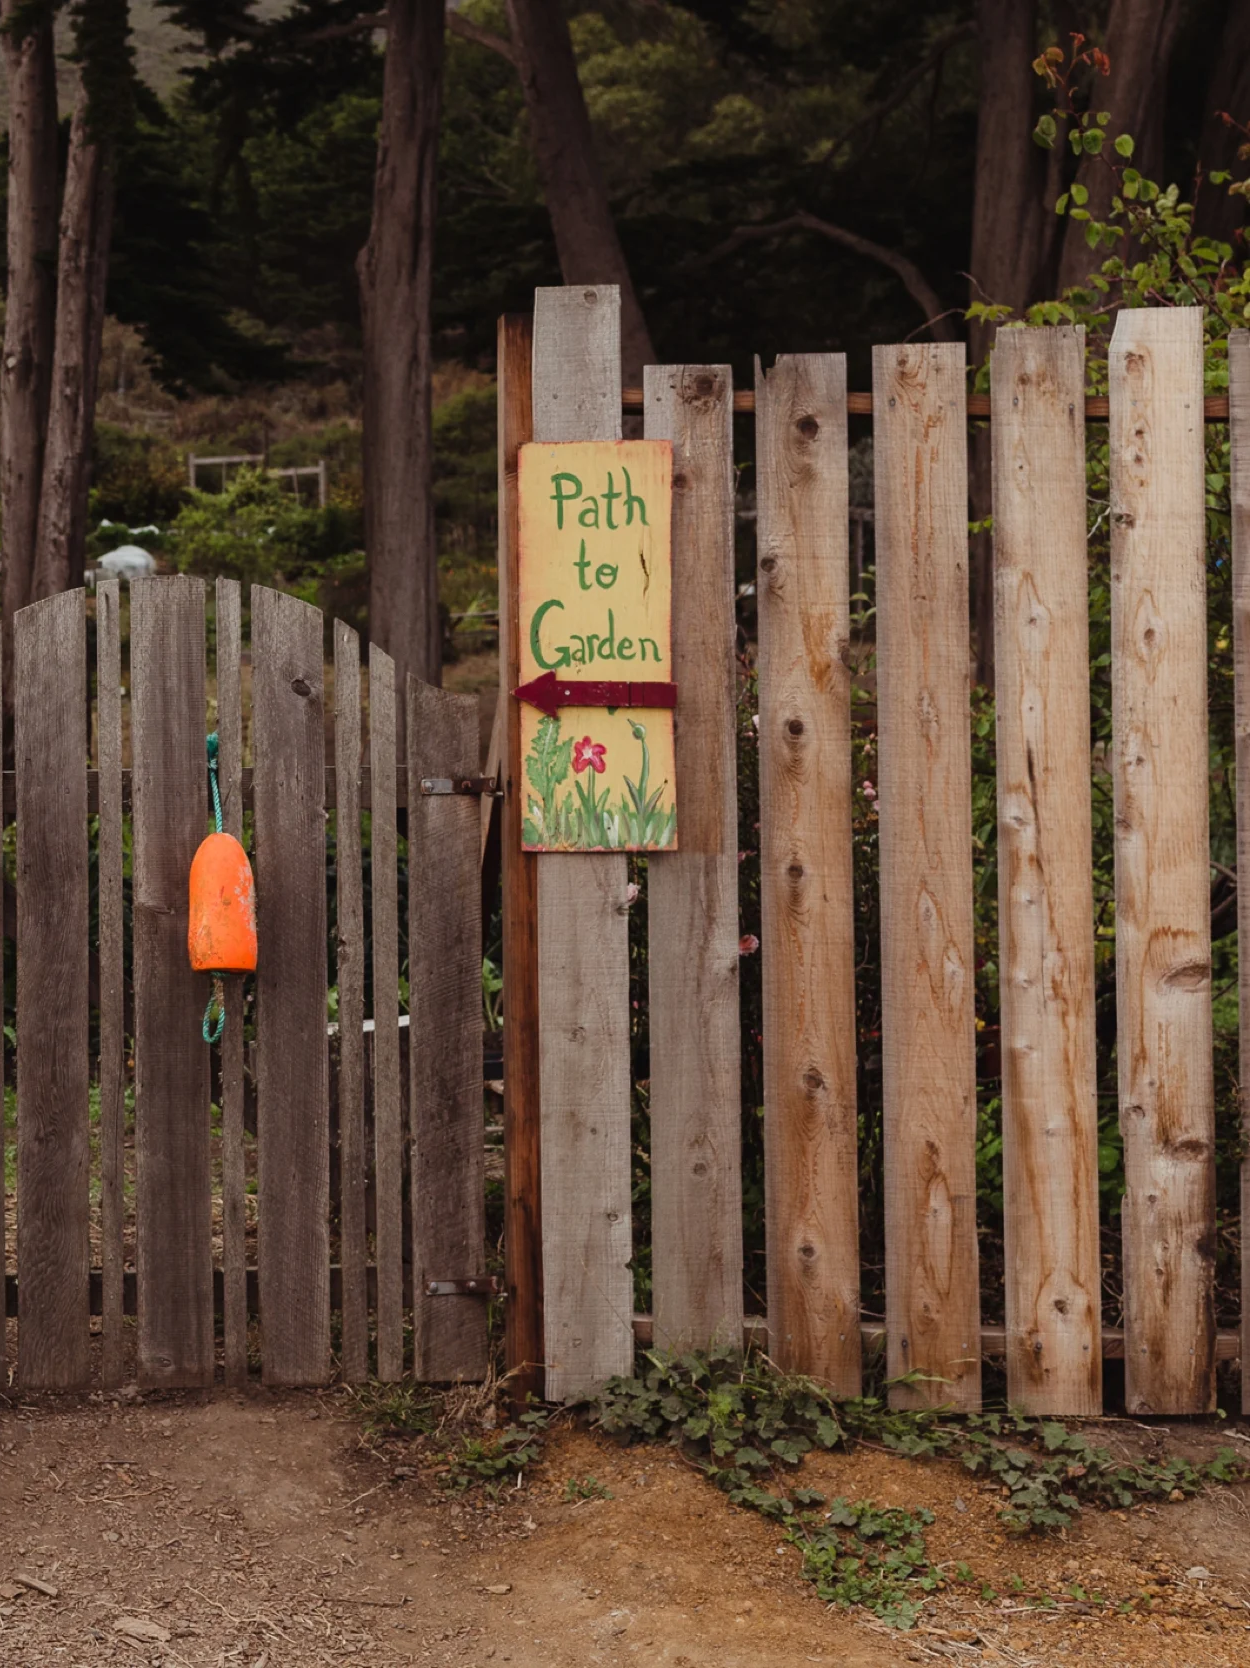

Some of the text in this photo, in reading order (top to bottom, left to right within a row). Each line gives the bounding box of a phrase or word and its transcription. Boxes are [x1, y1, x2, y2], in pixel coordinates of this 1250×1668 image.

[550, 466, 650, 530] Path
[573, 538, 619, 591] to
[530, 599, 663, 670] Garden
